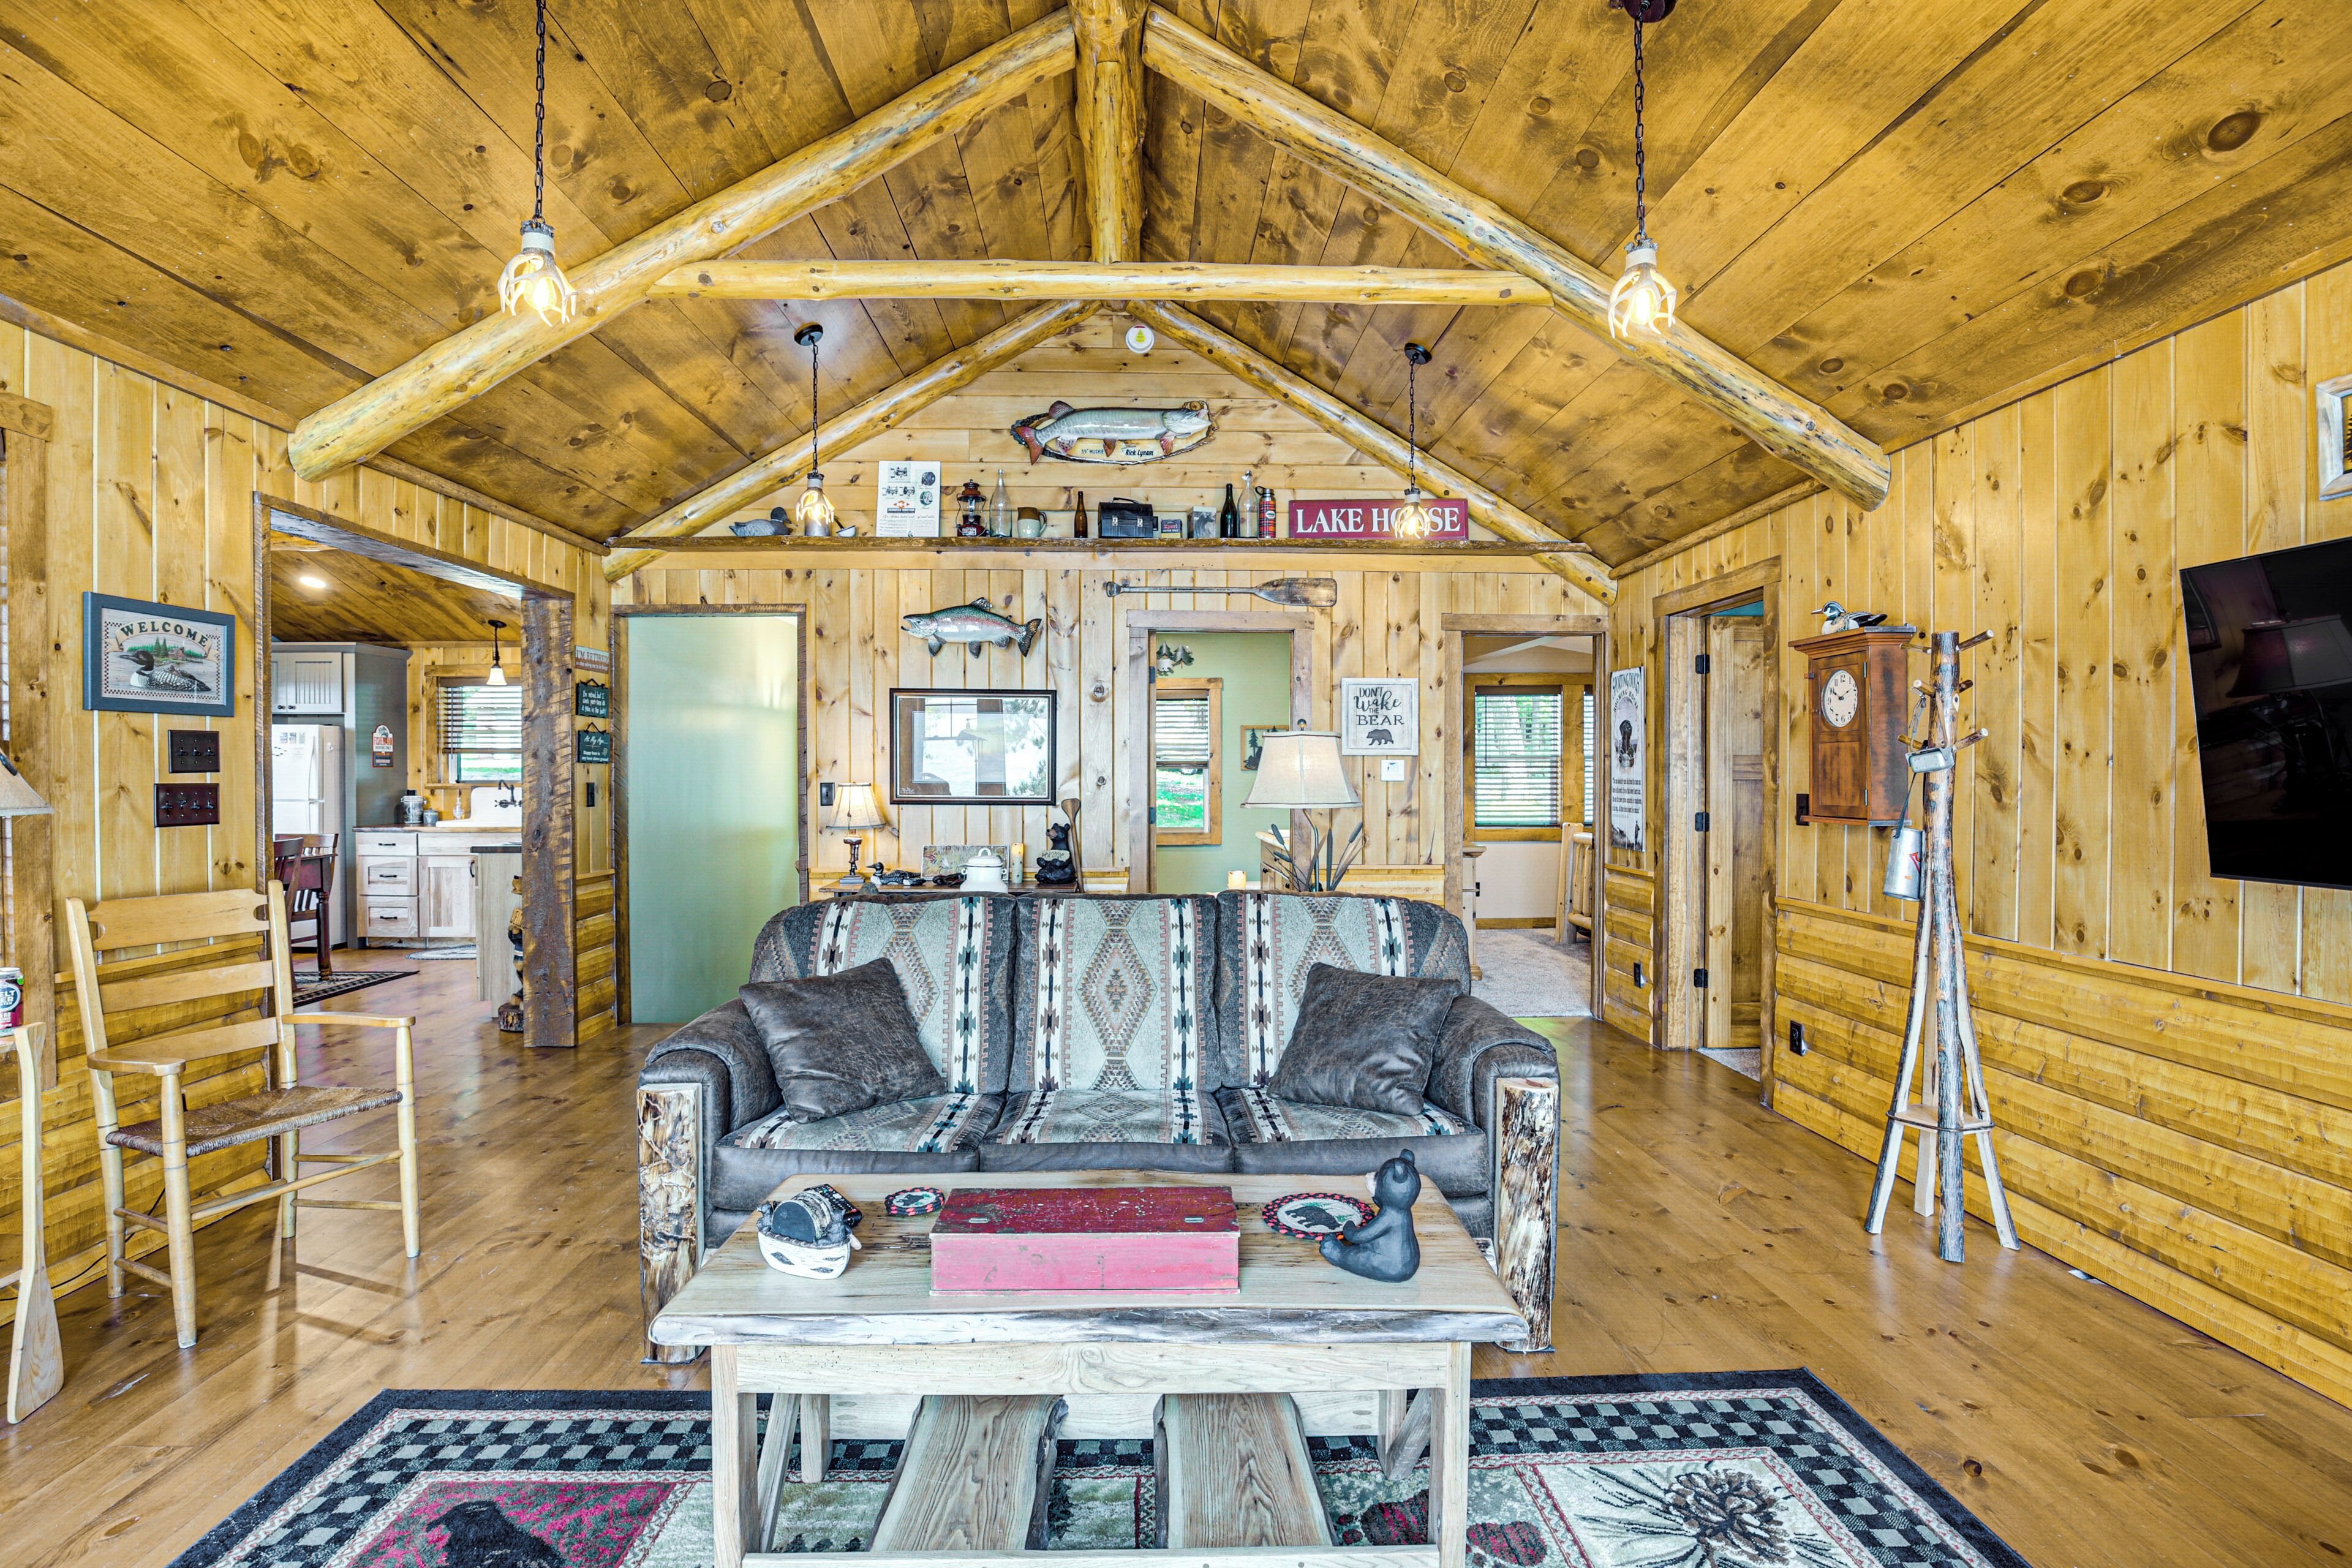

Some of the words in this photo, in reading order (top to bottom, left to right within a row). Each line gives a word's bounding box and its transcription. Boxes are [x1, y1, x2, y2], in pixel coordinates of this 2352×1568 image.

[1296, 508, 1365, 533] LAKE
[1371, 507, 1461, 532] HOSE
[121, 621, 208, 647] WELCOME
[1353, 690, 1402, 712] Wake
[1356, 715, 1405, 726] BEAR
